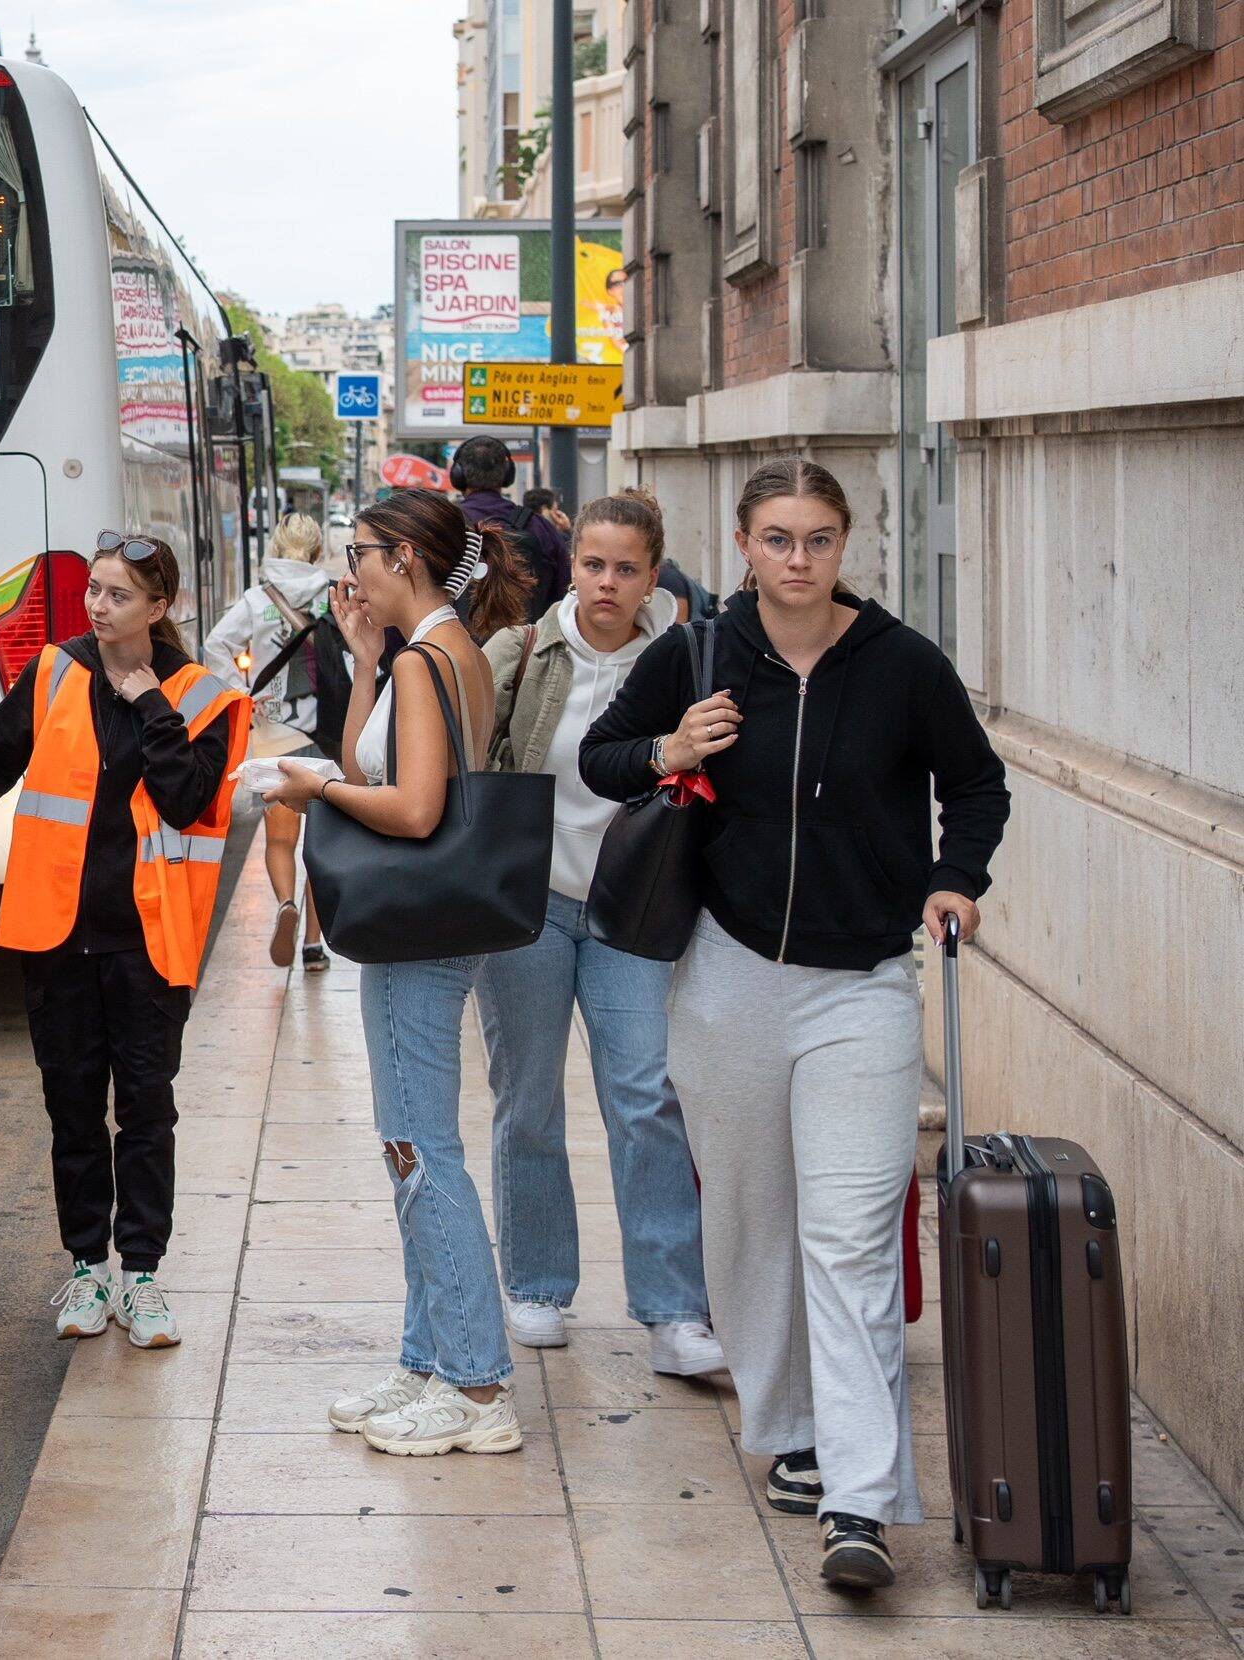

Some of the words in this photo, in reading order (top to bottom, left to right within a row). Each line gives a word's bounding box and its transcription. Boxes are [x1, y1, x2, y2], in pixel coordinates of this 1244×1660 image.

[425, 240, 470, 250] SALON
[425, 254, 516, 270] PISCINE
[425, 275, 469, 291] SPA
[435, 295, 516, 312] JARDIN
[421, 343, 484, 362] NICE
[516, 371, 533, 383] des
[539, 372, 578, 387] Anglais
